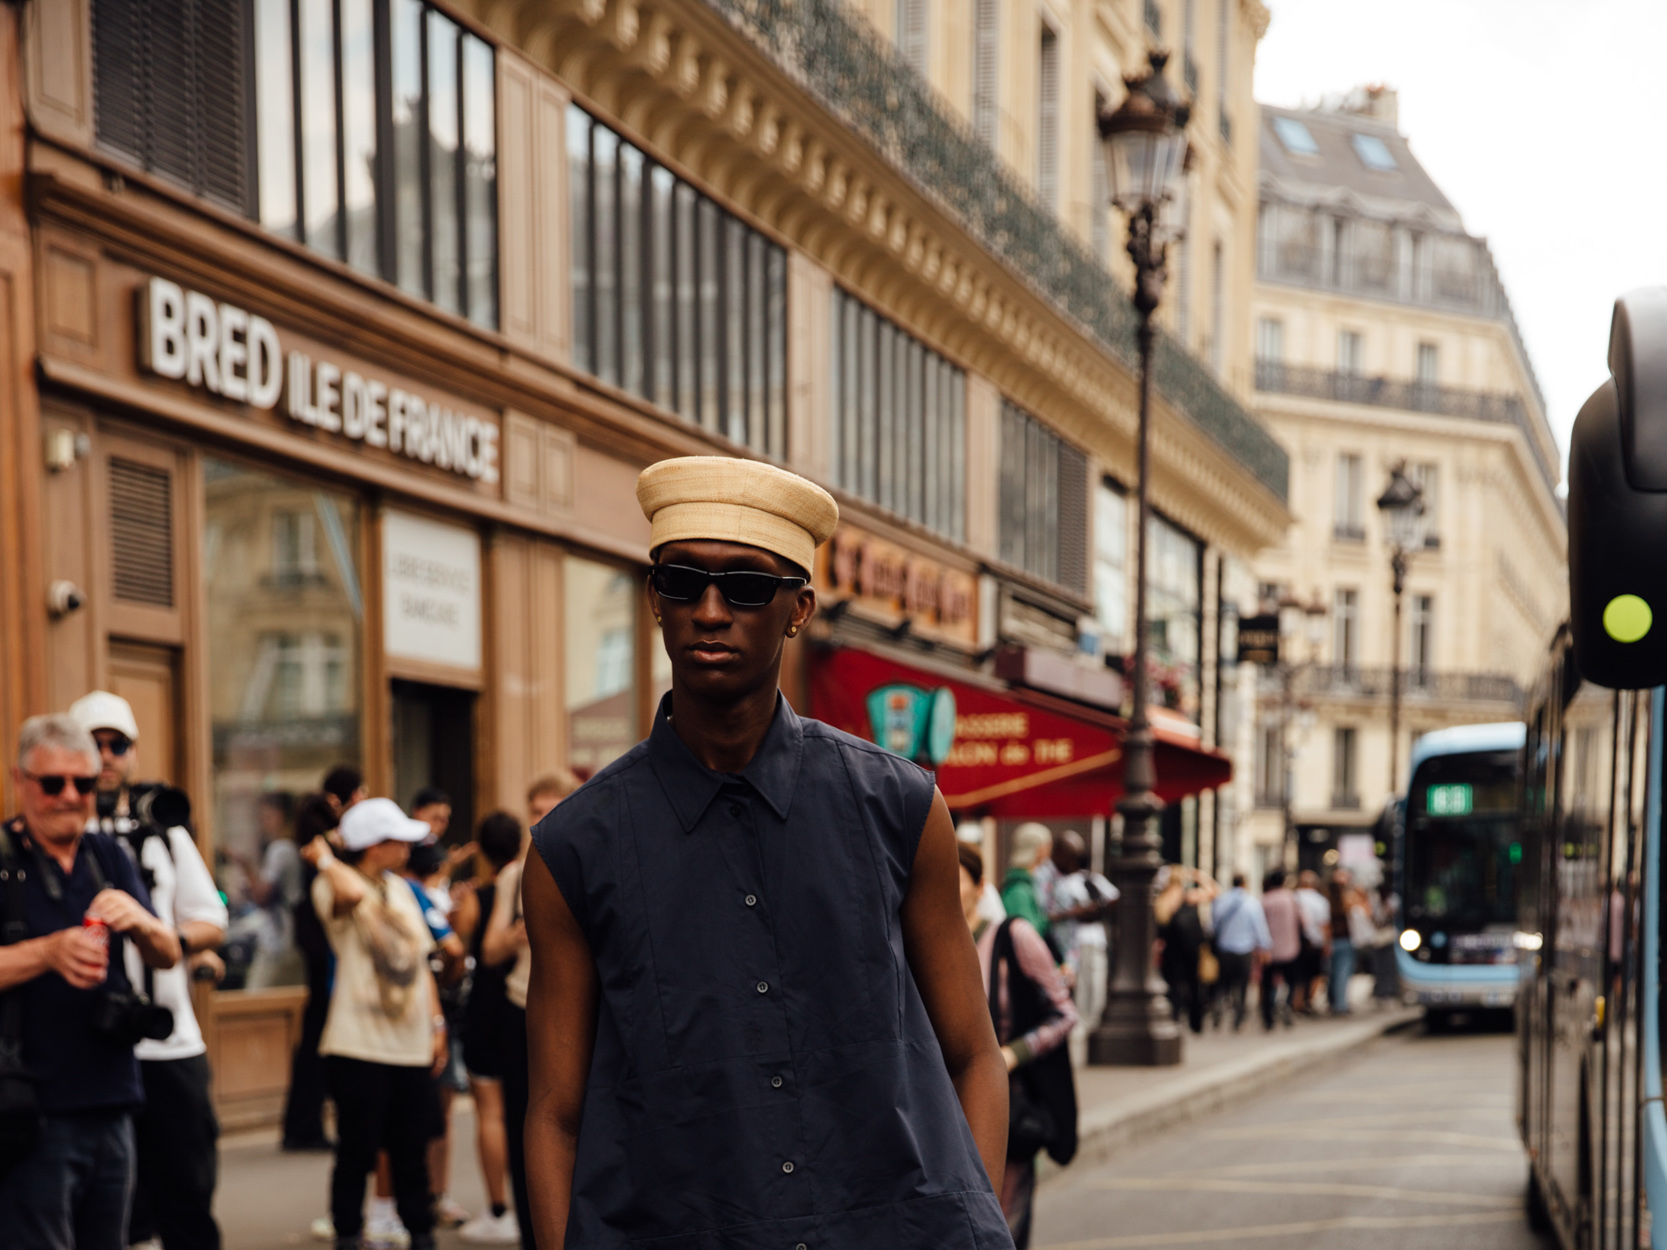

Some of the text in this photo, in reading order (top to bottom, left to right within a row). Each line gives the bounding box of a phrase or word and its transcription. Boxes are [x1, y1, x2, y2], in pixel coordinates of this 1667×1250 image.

[149, 277, 499, 484] BRED ILE DE FRANCE
[954, 712, 1028, 739] ASSERIE
[944, 741, 998, 767] ALON
